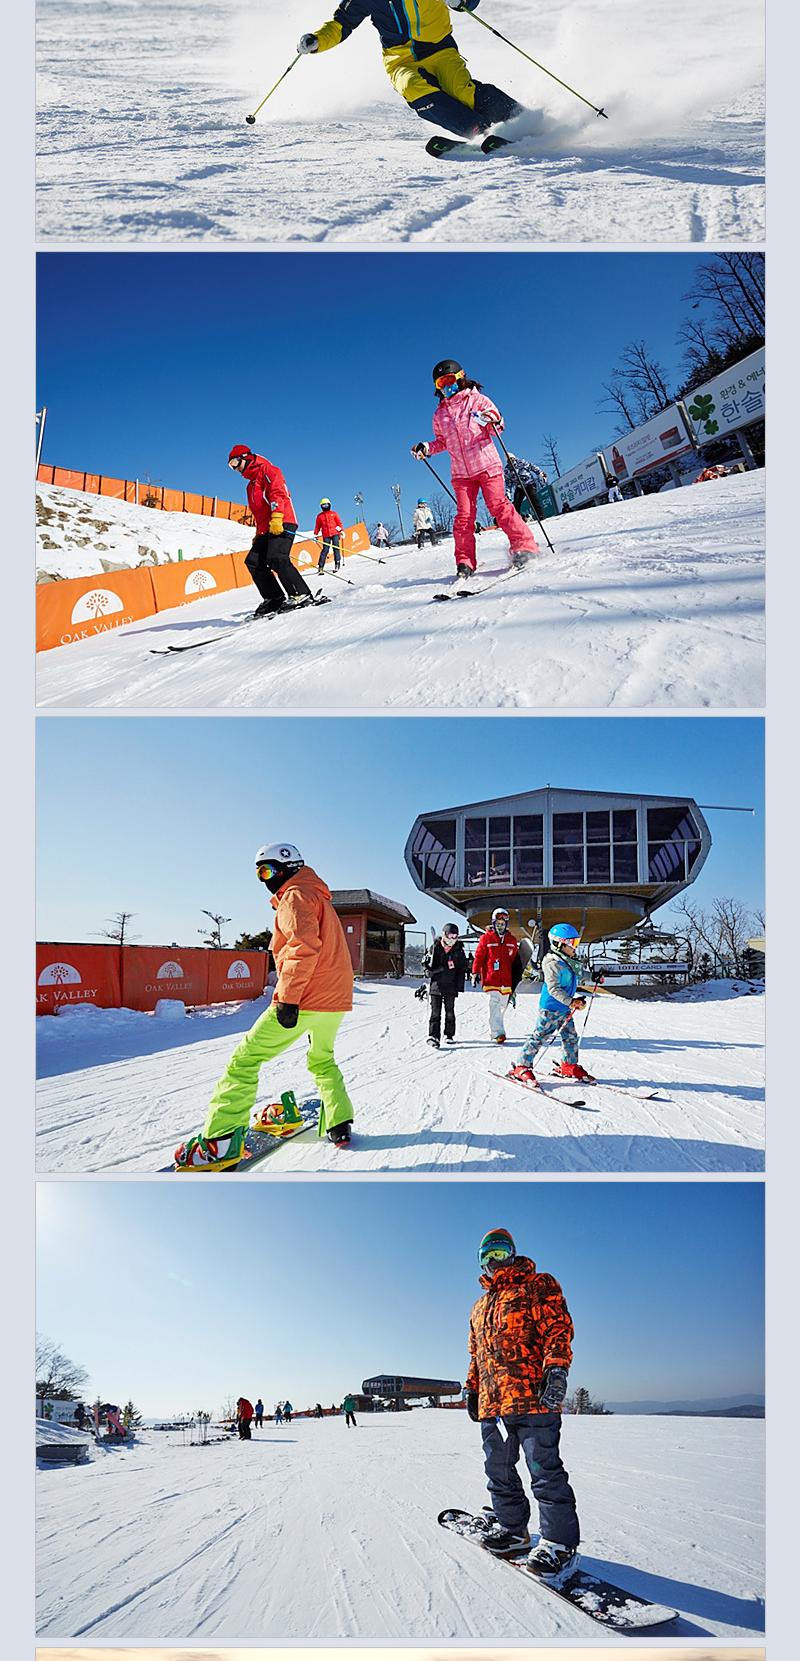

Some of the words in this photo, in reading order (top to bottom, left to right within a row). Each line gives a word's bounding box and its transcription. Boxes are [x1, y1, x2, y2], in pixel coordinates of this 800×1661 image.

[720, 384, 737, 400] 환경
[738, 379, 747, 390] &
[720, 384, 765, 424] 한솔
[60, 629, 89, 645] OAK
[53, 989, 98, 1001] VALLEY
[145, 984, 163, 993] OAK
